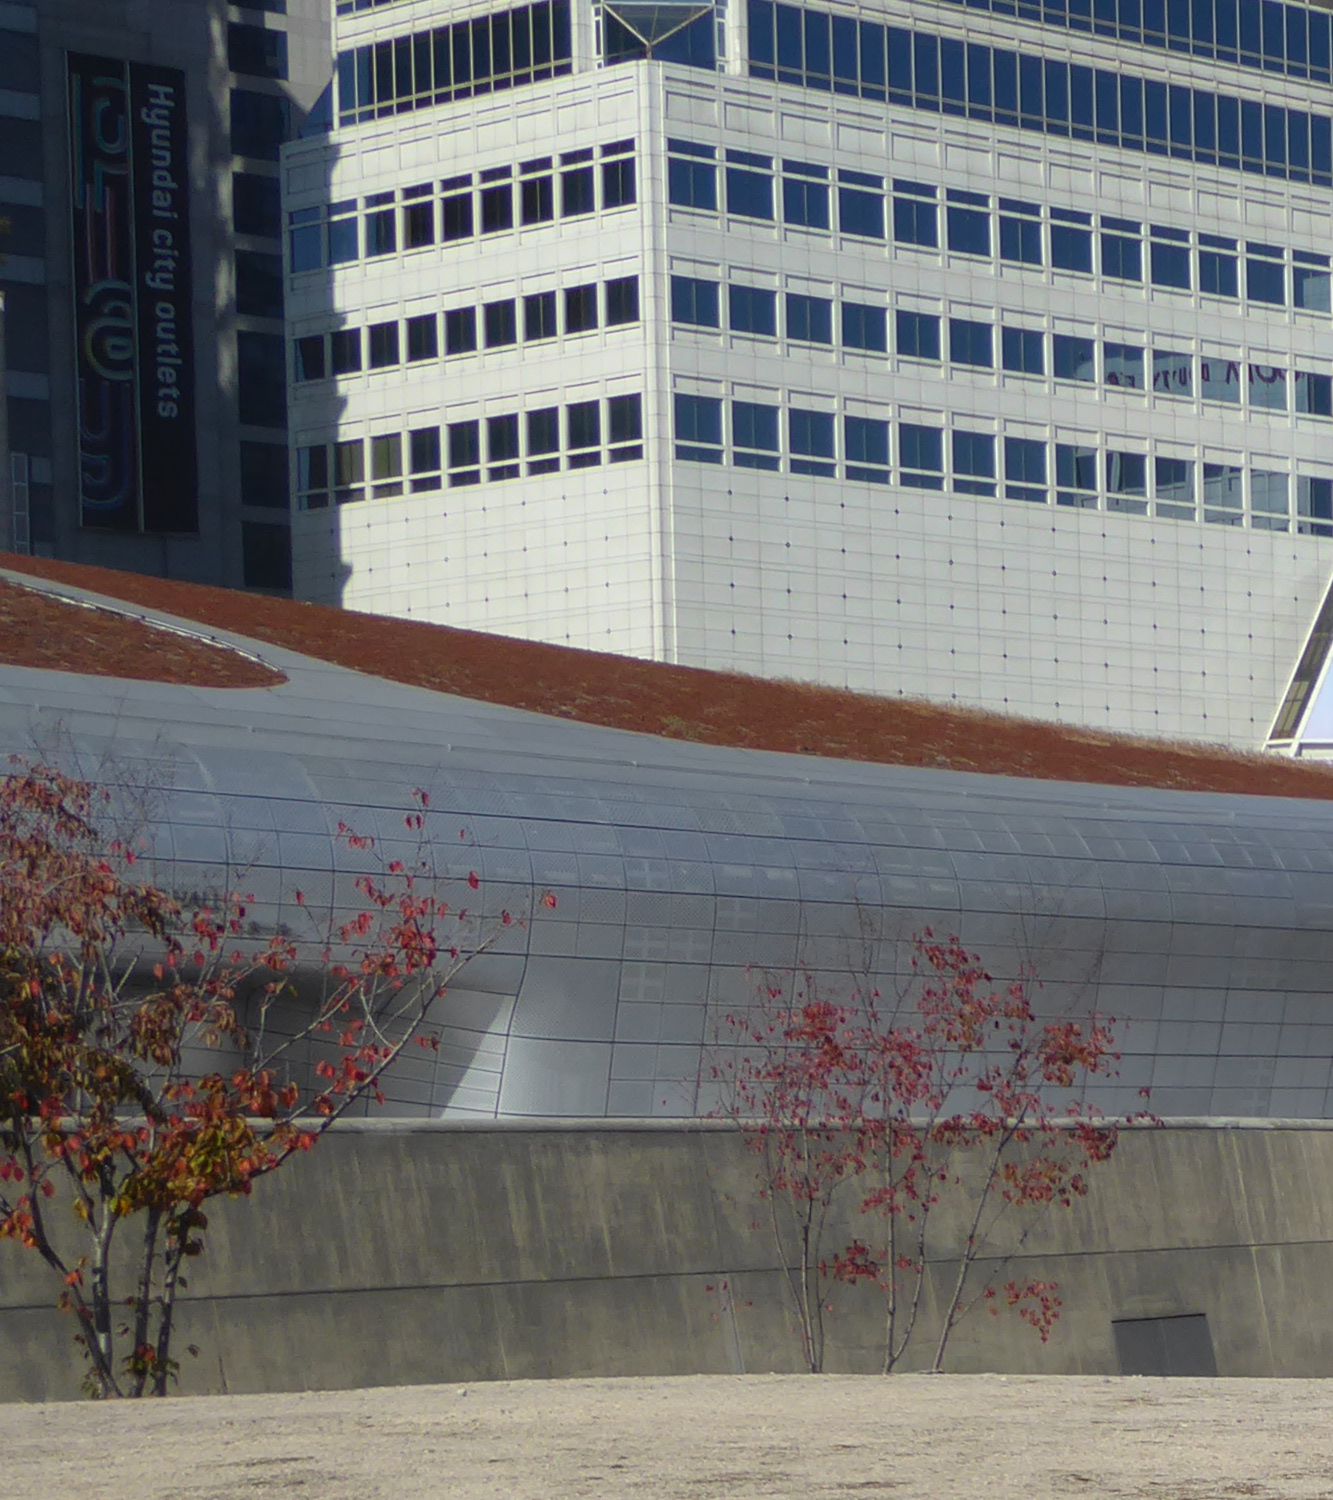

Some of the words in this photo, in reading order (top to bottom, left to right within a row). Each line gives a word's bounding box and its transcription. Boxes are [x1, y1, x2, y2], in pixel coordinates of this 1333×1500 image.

[141, 83, 178, 219] Hyundai
[146, 229, 178, 293] city
[155, 301, 181, 419] outlets
